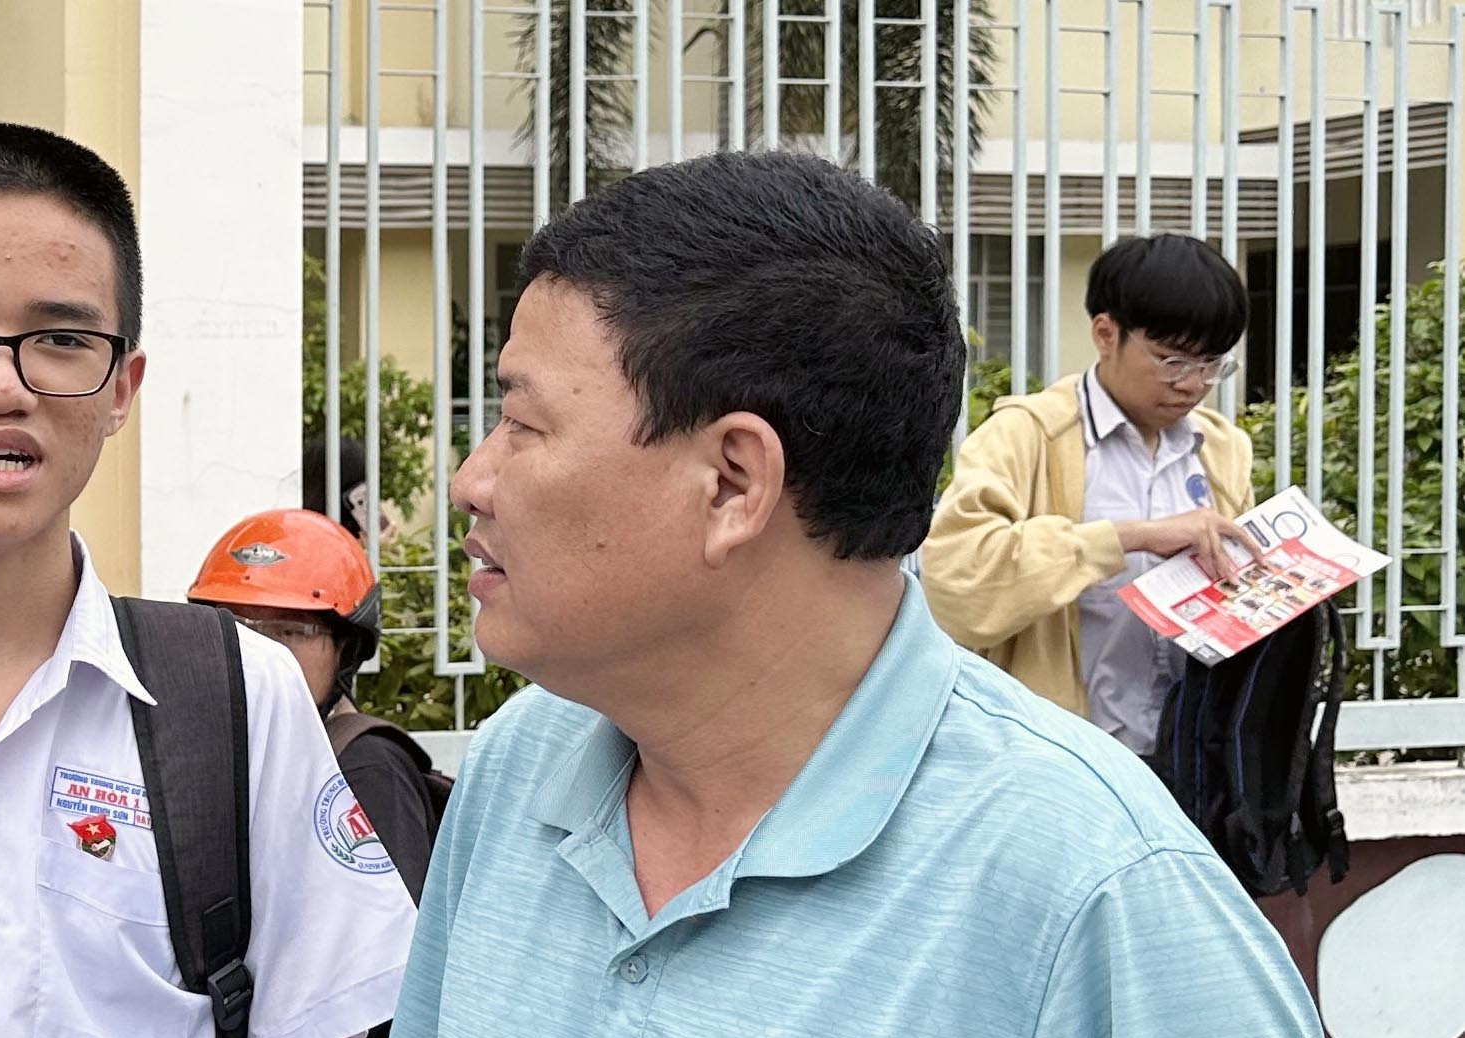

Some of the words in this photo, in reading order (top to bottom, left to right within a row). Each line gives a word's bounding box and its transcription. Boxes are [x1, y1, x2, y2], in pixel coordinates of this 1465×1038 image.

[67, 783, 90, 798] AN
[95, 787, 128, 806] HÒA
[135, 798, 140, 809] 1
